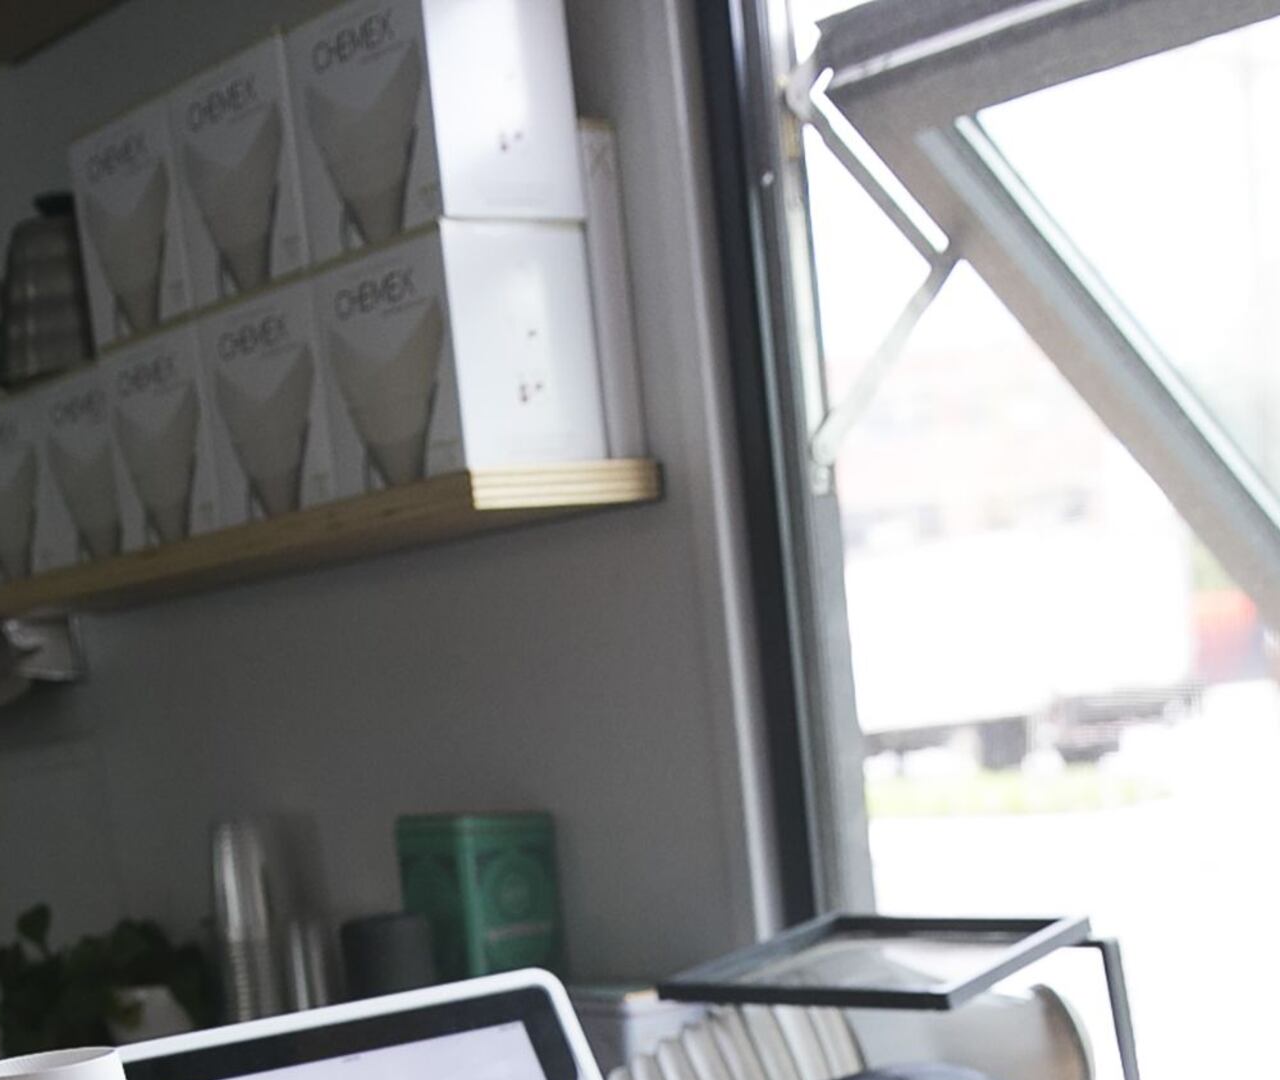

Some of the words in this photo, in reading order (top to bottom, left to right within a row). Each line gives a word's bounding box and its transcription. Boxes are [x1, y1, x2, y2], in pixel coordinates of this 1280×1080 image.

[311, 8, 396, 74] CHEMEX
[187, 75, 258, 132] CHEMEX
[334, 269, 417, 321] CHEMEX
